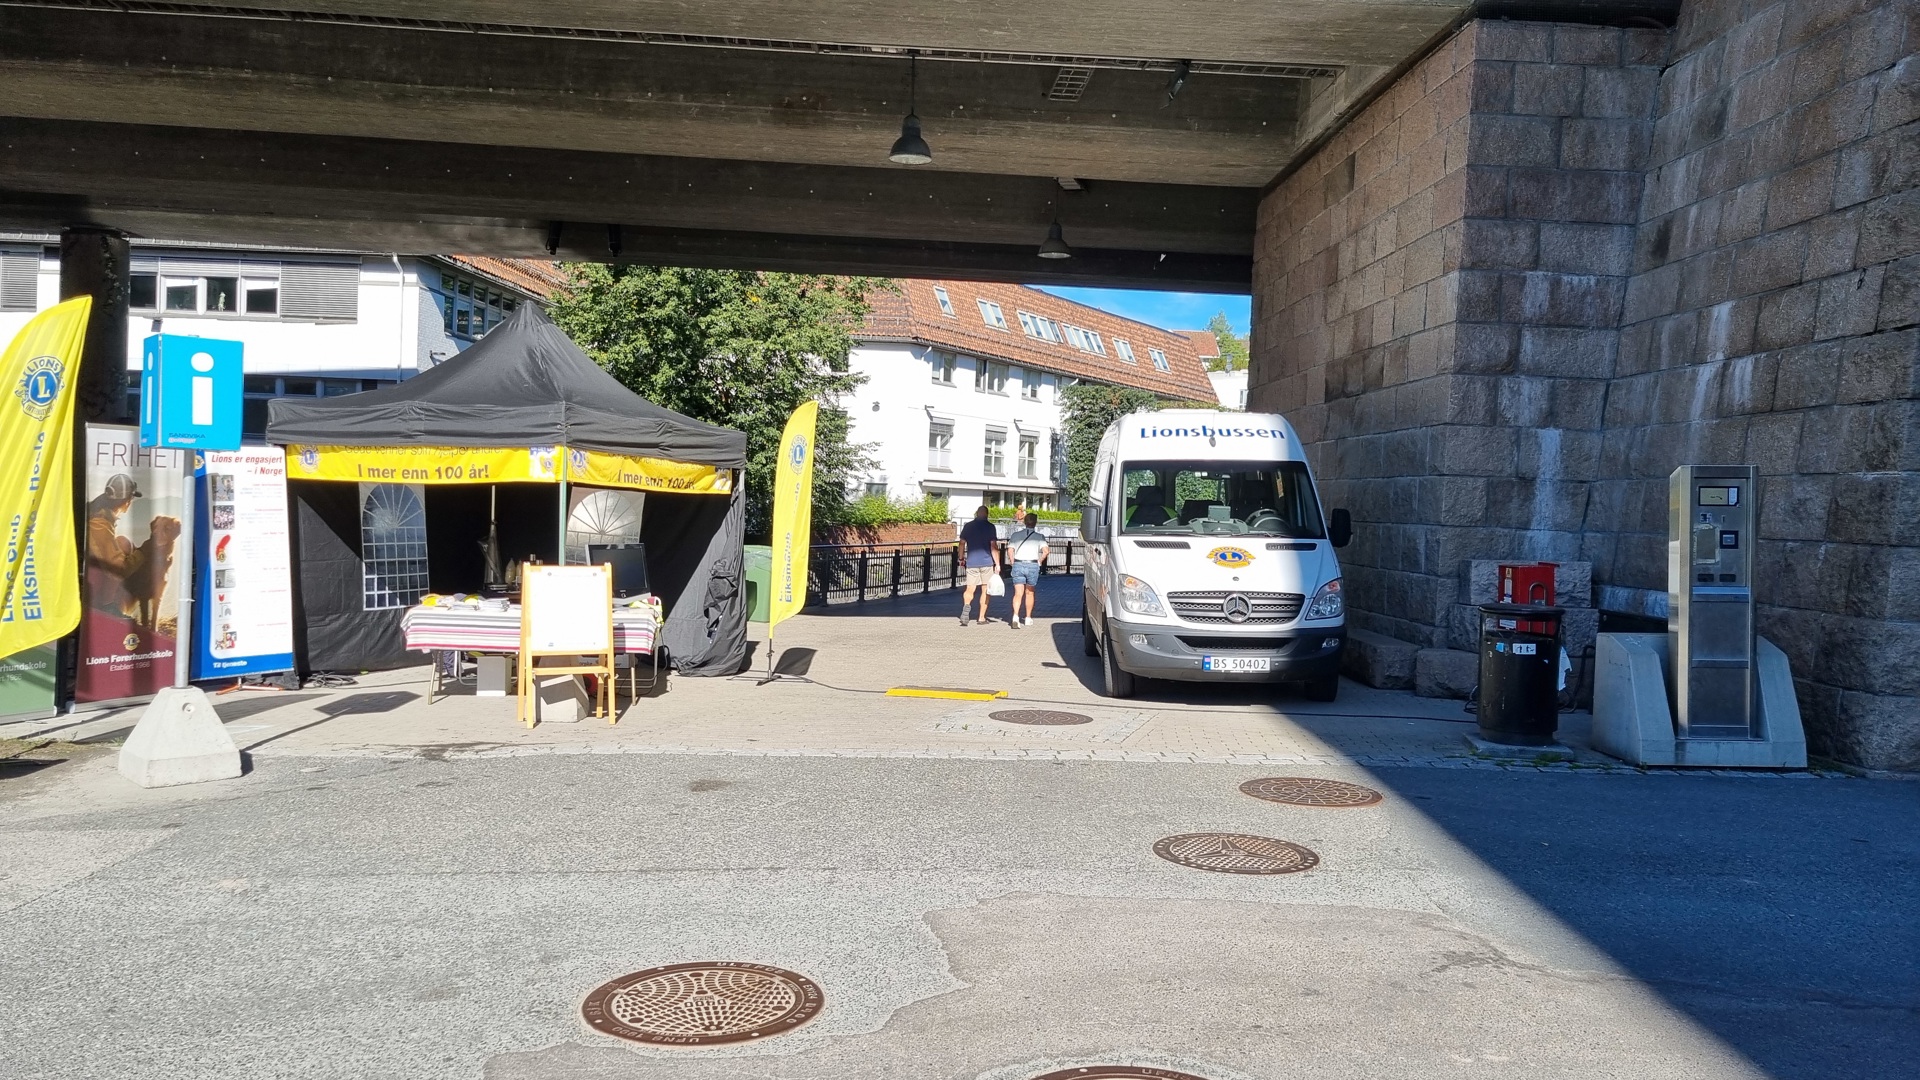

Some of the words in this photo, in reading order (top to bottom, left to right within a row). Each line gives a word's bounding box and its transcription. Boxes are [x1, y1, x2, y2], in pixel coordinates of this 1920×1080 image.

[26, 358, 60, 374] LIONS
[1140, 425, 1286, 440] Lionsbussen
[211, 453, 233, 464] Lions
[234, 456, 243, 464] er
[245, 455, 283, 466] engasjert
[259, 467, 283, 477] Norge
[367, 467, 397, 479] mer
[401, 468, 429, 480] enn
[435, 466, 463, 479] 100
[468, 464, 490, 479] år!
[623, 473, 643, 485] mer
[86, 656, 110, 666] Lions
[1213, 658, 1227, 669] BS
[1232, 658, 1267, 670] 50402
